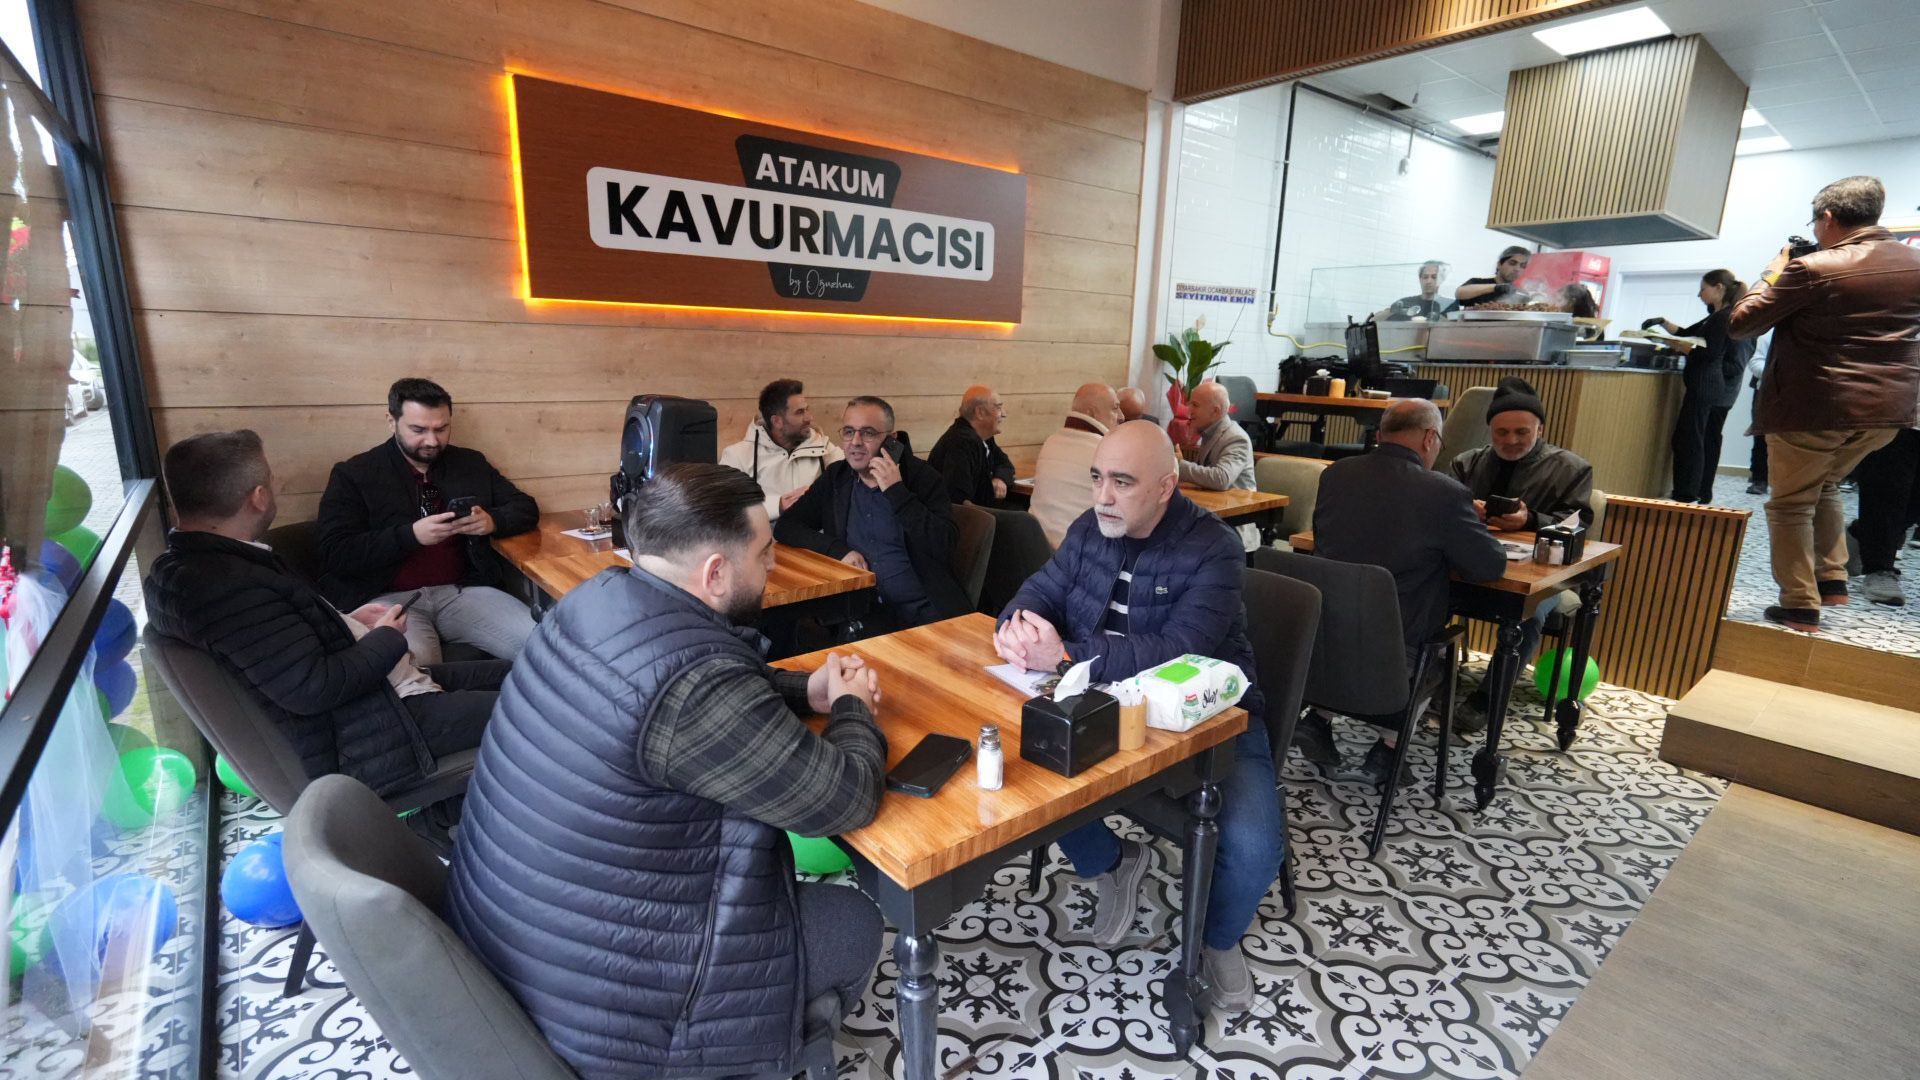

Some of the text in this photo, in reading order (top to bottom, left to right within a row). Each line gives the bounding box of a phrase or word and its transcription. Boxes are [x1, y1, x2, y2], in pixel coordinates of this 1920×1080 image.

[756, 152, 885, 199] ATAKUM
[606, 181, 985, 271] KAVURMACISI
[788, 267, 803, 296] by
